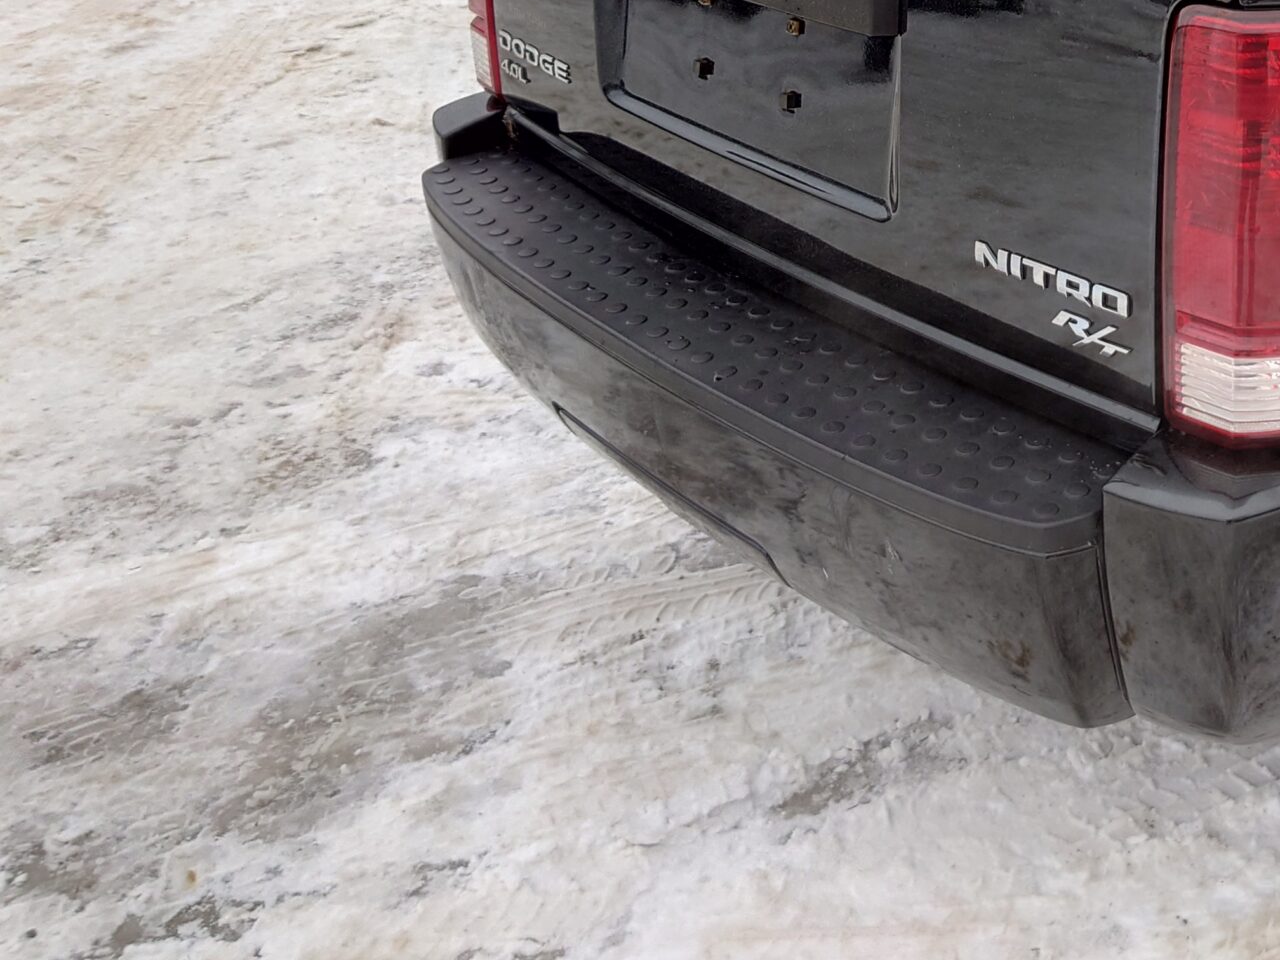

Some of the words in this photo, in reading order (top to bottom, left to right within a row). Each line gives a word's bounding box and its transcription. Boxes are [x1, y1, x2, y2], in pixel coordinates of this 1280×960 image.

[498, 28, 571, 84] DODGE
[974, 239, 1132, 318] NITRO
[1051, 309, 1132, 357] R/T
